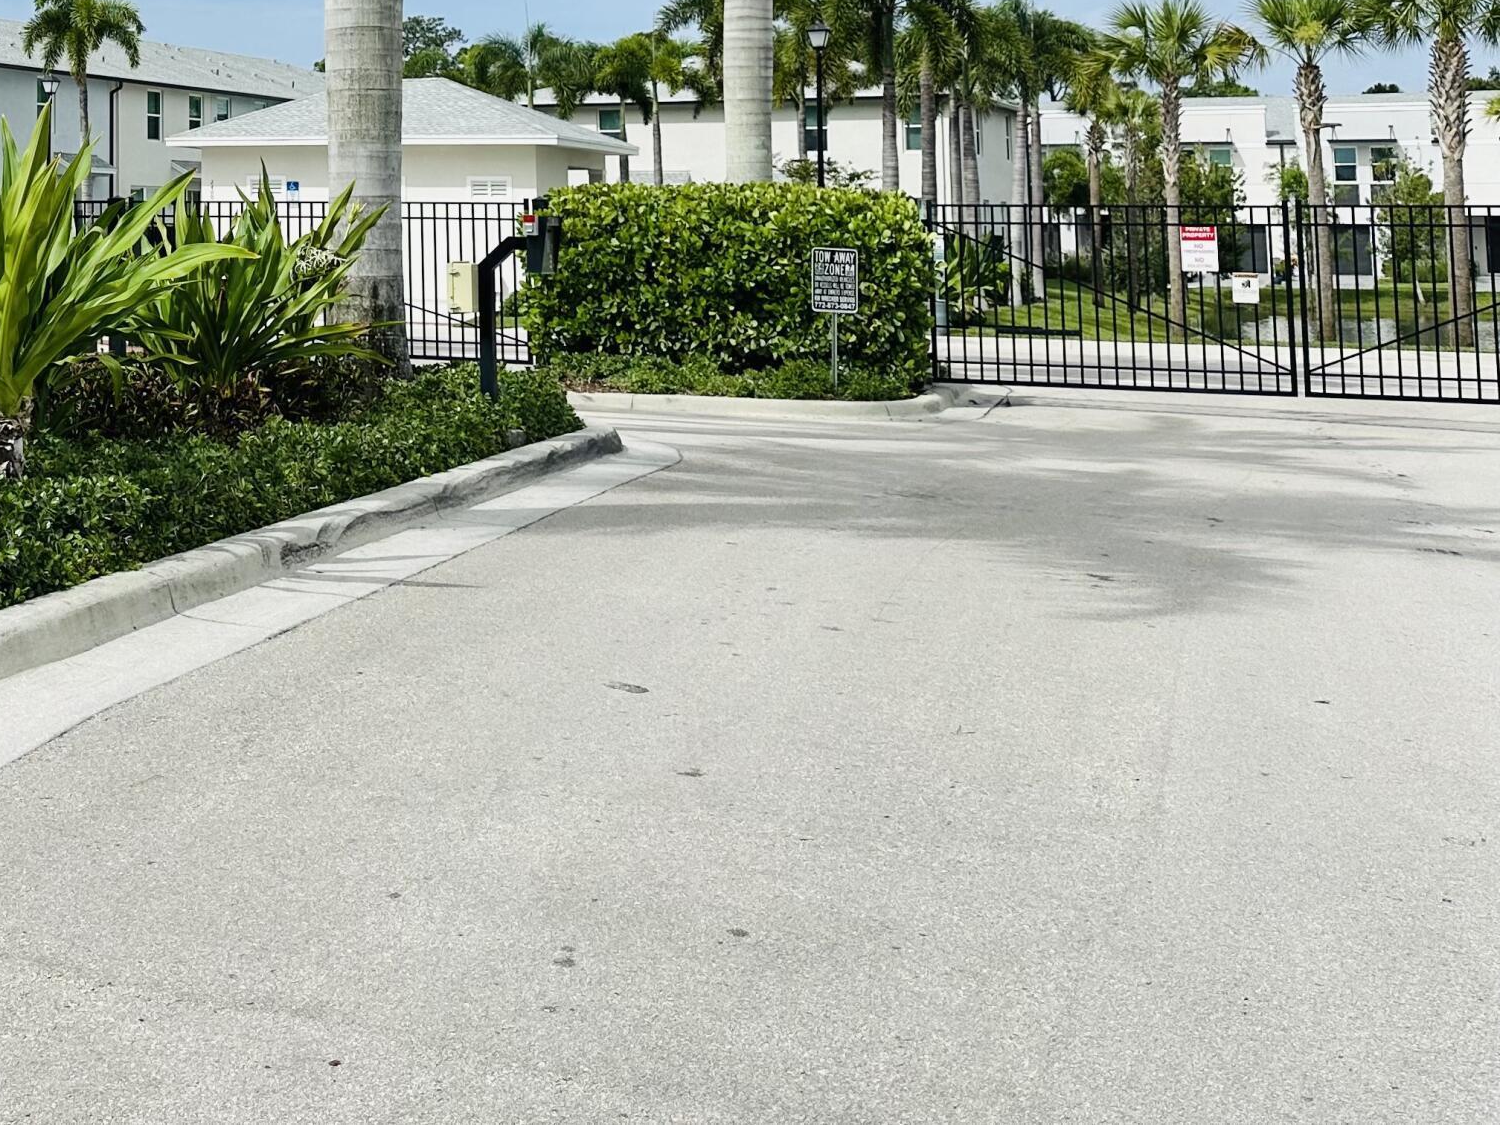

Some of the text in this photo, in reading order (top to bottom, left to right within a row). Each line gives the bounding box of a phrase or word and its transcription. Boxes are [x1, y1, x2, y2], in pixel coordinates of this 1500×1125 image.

[815, 251, 855, 264] TOW AWAY
[824, 264, 844, 276] ZONE
